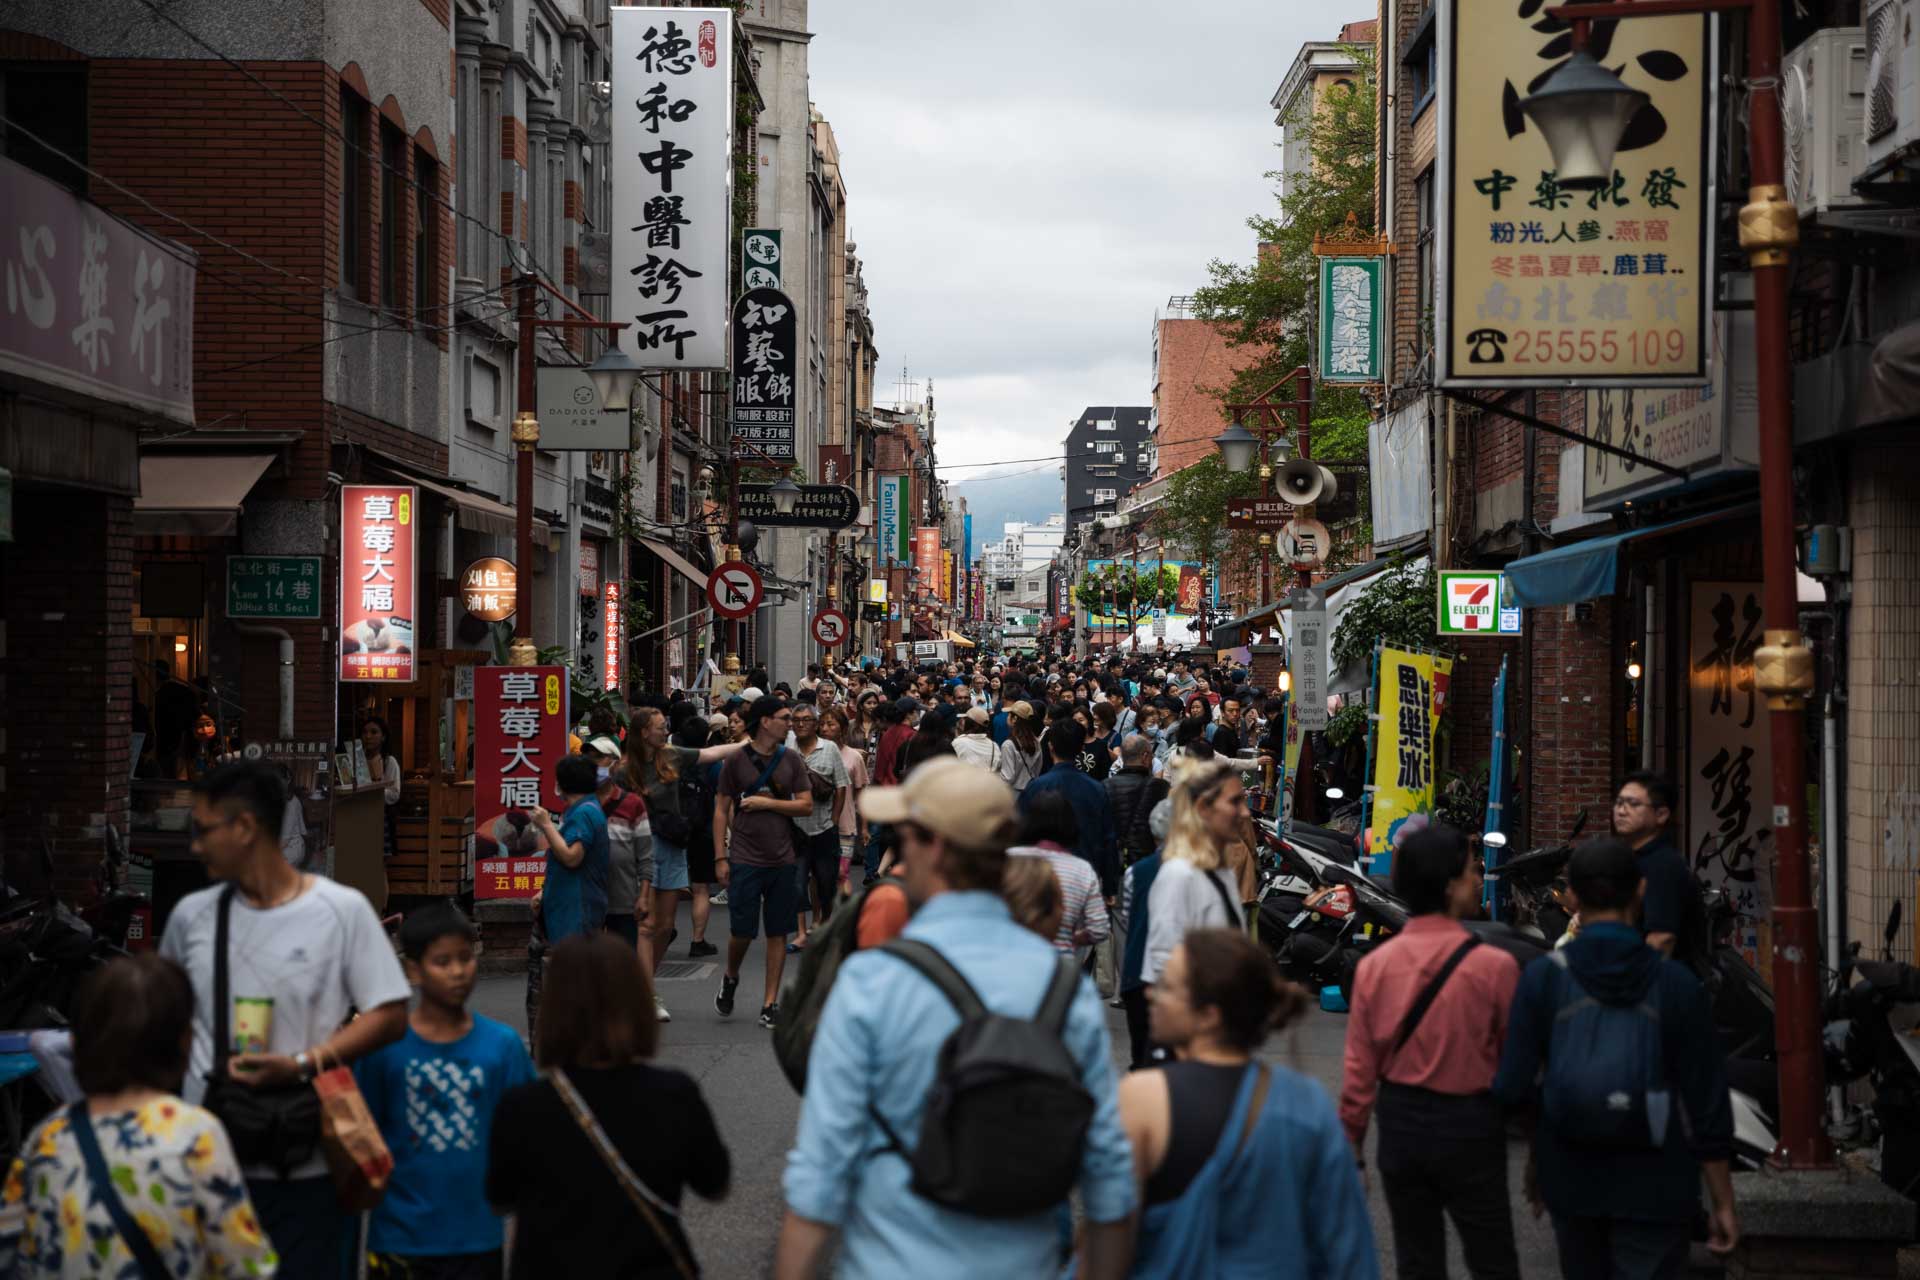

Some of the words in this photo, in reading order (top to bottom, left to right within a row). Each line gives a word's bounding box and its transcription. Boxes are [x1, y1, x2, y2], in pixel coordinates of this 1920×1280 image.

[630, 21, 702, 361] 德和中醫診所
[1473, 167, 1686, 212] 中藥批發
[749, 238, 776, 262] 被單
[1475, 280, 1689, 323] 南北雜貨
[1513, 329, 1685, 367] 25555109
[881, 483, 896, 553] FamilyMart
[362, 495, 395, 612] 草莓大福
[265, 581, 285, 599] 14
[292, 580, 312, 600] 巷
[467, 569, 499, 587] 刈包
[467, 594, 500, 611] 油飯
[1303, 648, 1317, 704] 永樂市場
[1297, 706, 1325, 716] Yongle
[1297, 717, 1325, 725] Market
[1397, 663, 1423, 789] 思樂冰
[499, 672, 541, 808] 草莓大福
[495, 876, 545, 890] 五顆星
